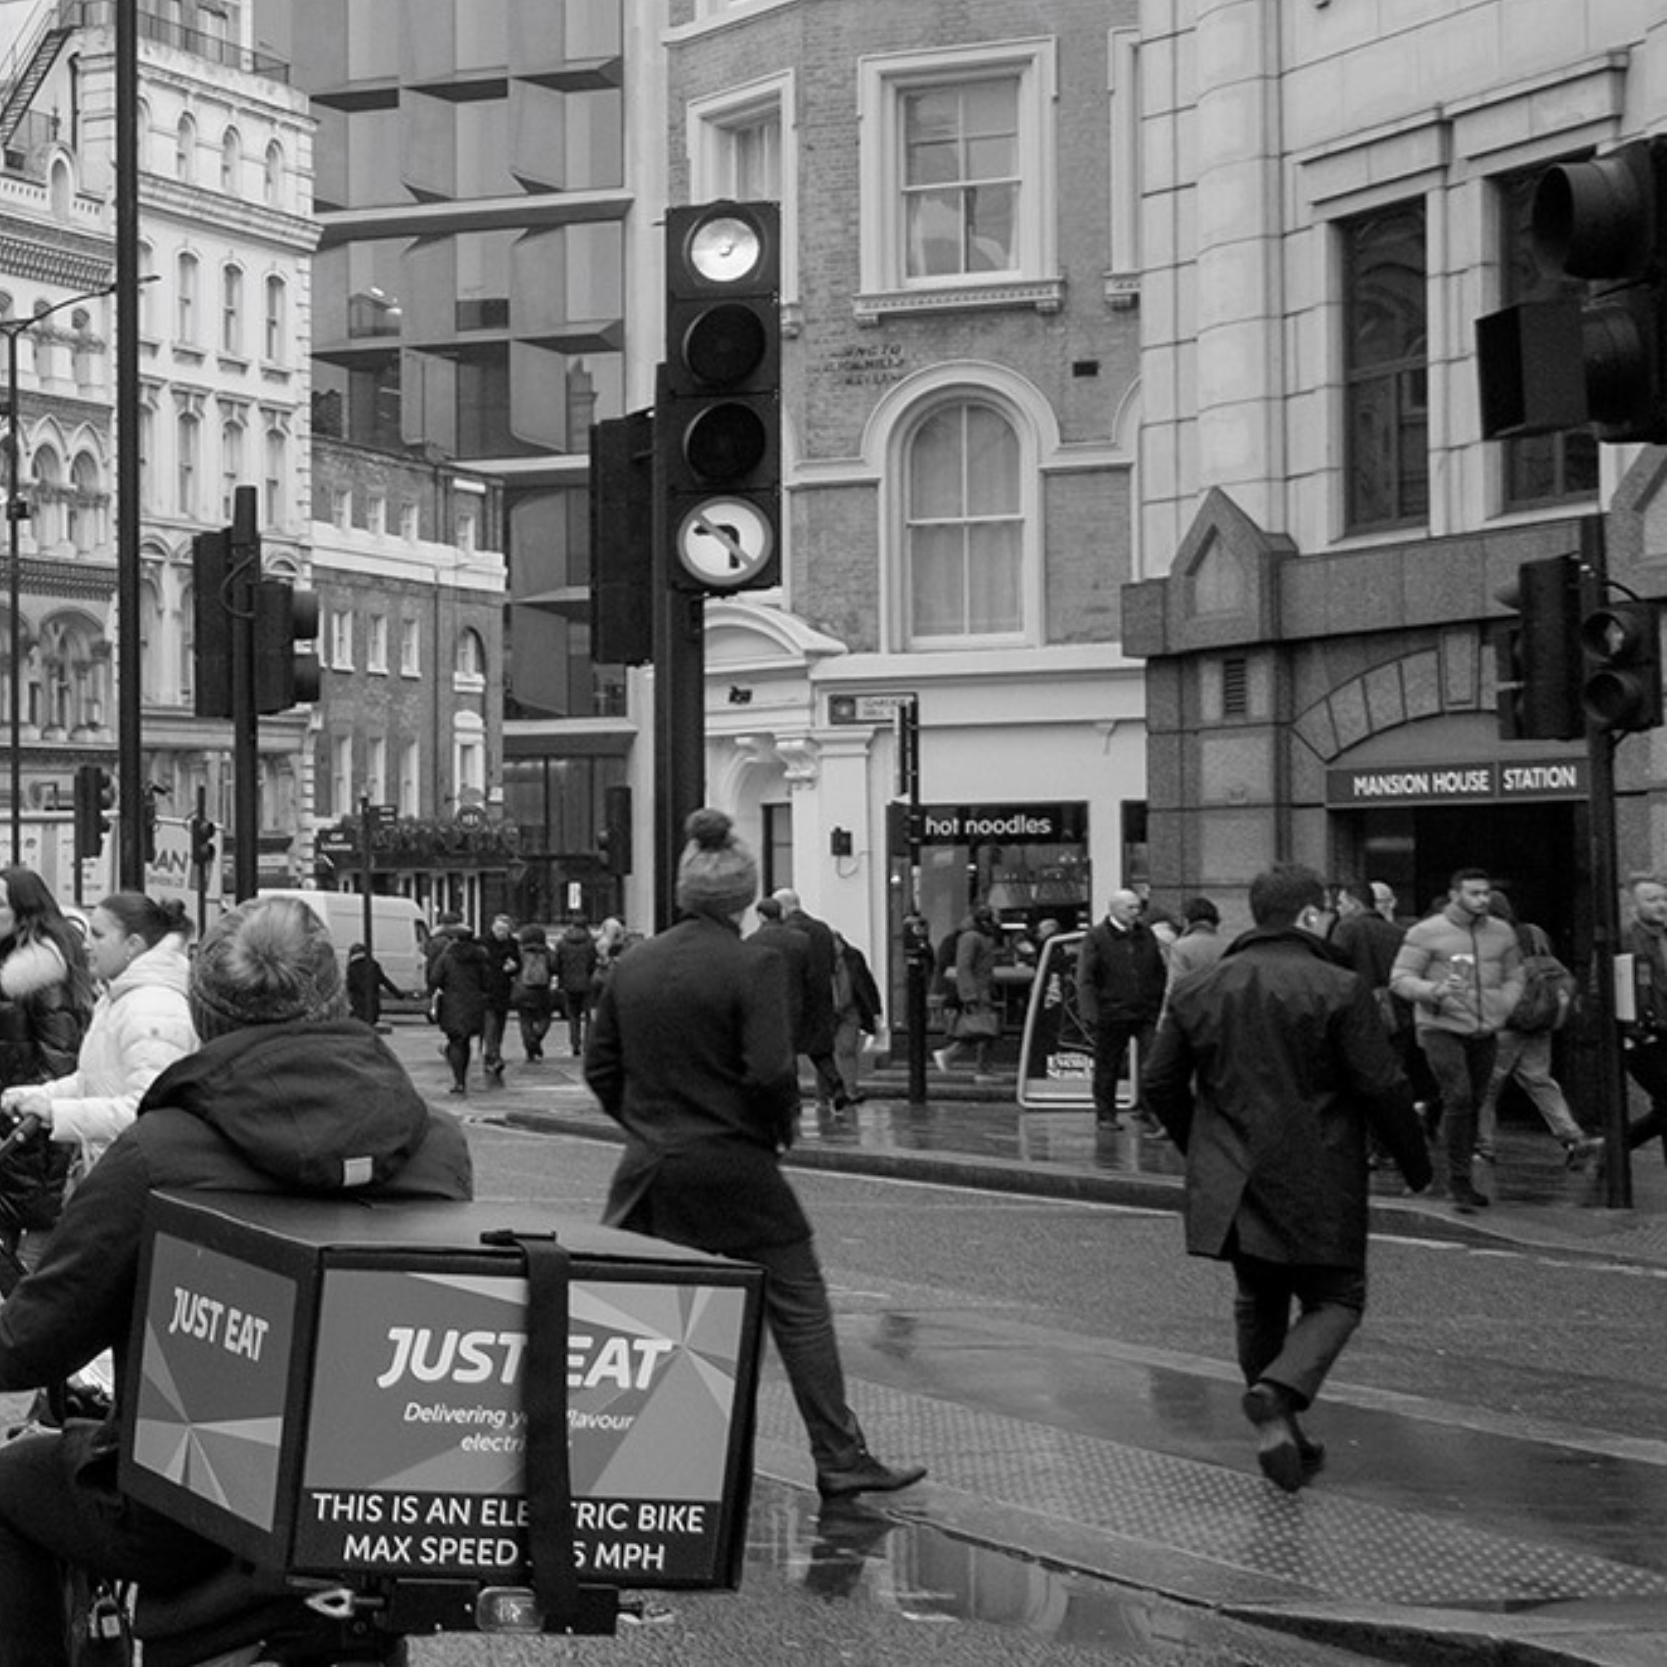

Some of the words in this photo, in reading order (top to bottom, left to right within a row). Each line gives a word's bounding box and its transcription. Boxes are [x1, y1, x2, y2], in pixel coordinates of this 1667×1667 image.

[1354, 773, 1429, 796] MANSION
[1432, 769, 1490, 792] HOUSE
[1503, 765, 1577, 791] STATION
[965, 813, 1052, 834] noodles
[169, 1286, 224, 1343] JUST
[224, 1306, 269, 1361] EAT
[376, 1327, 528, 1388] JUST
[568, 1335, 672, 1389] EAT
[403, 1401, 506, 1429] Delivering
[312, 1492, 383, 1523] THIS
[392, 1495, 418, 1524] IS
[425, 1497, 470, 1527] AN
[480, 1499, 629, 1531] ELERIC
[637, 1503, 705, 1533] BIKE
[342, 1534, 413, 1563] MAX
[419, 1537, 519, 1566] SPEED
[594, 1542, 665, 1571] MPH
